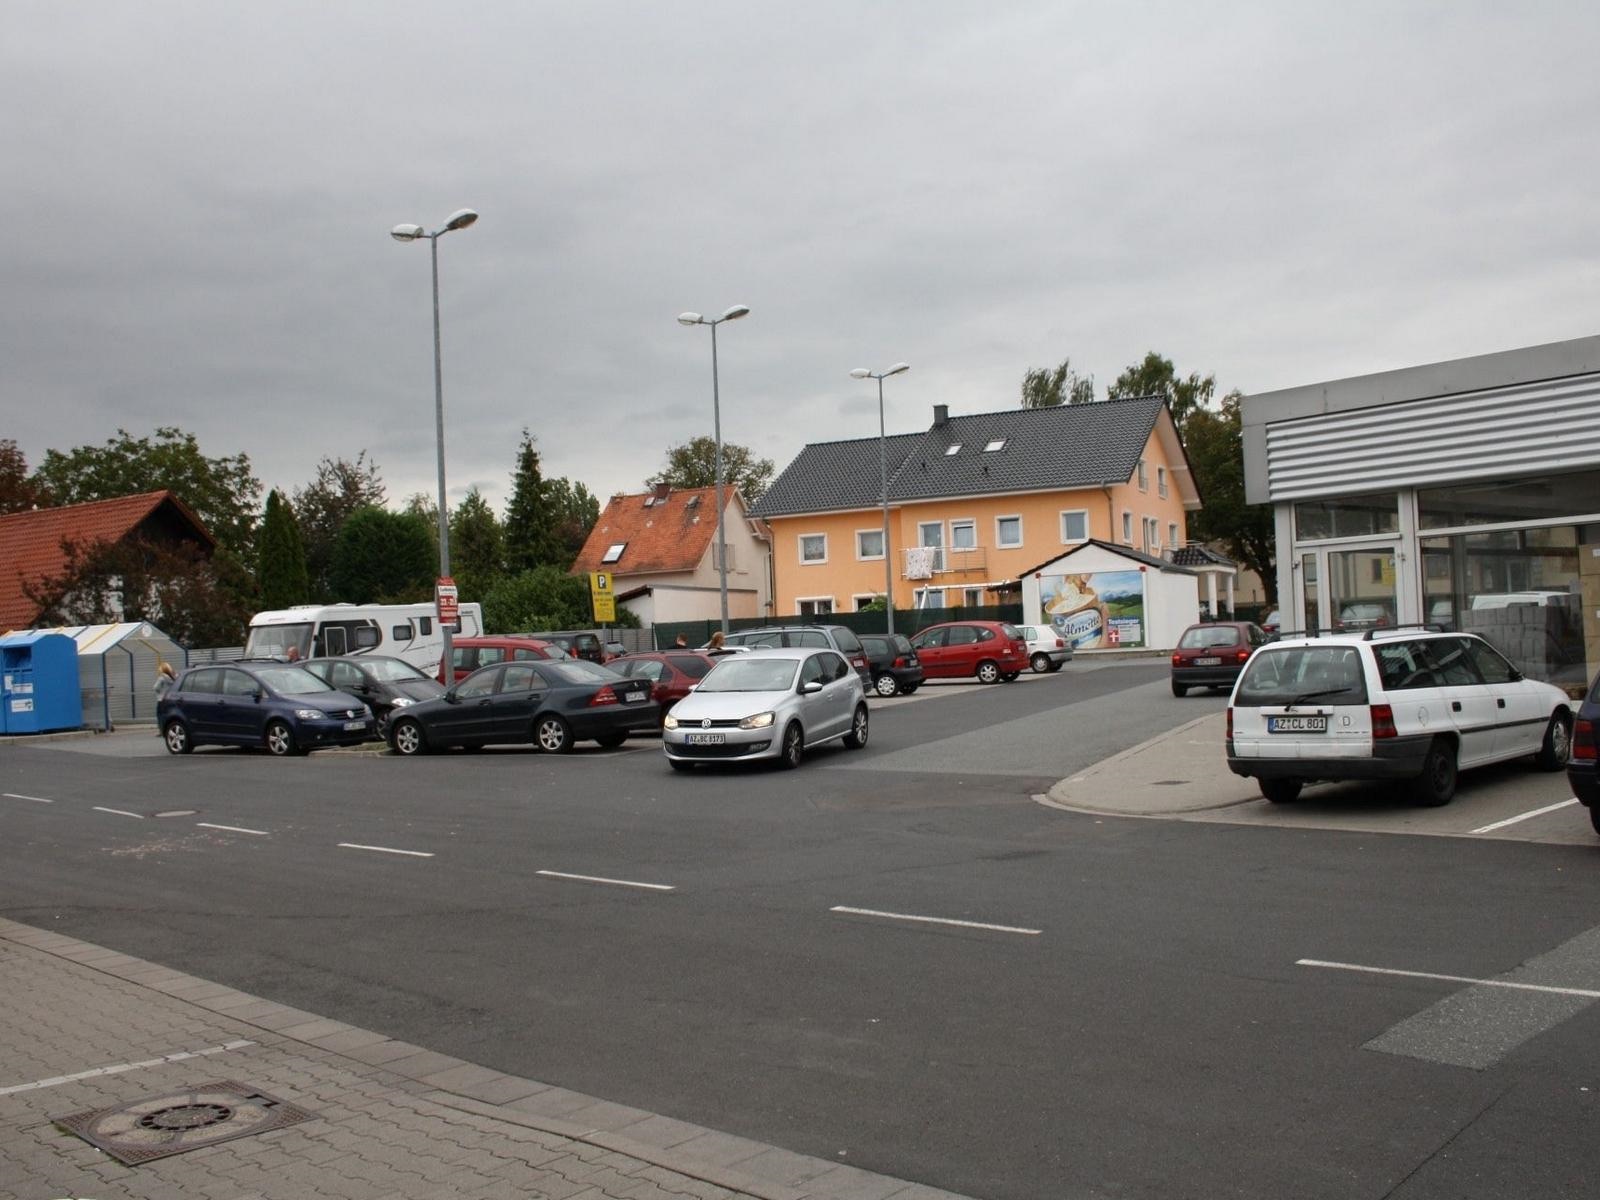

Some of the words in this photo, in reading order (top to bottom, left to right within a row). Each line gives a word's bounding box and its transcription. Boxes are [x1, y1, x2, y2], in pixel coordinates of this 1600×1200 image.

[599, 575, 605, 588] P
[1307, 719, 1324, 729] 801
[1342, 716, 1351, 726] D
